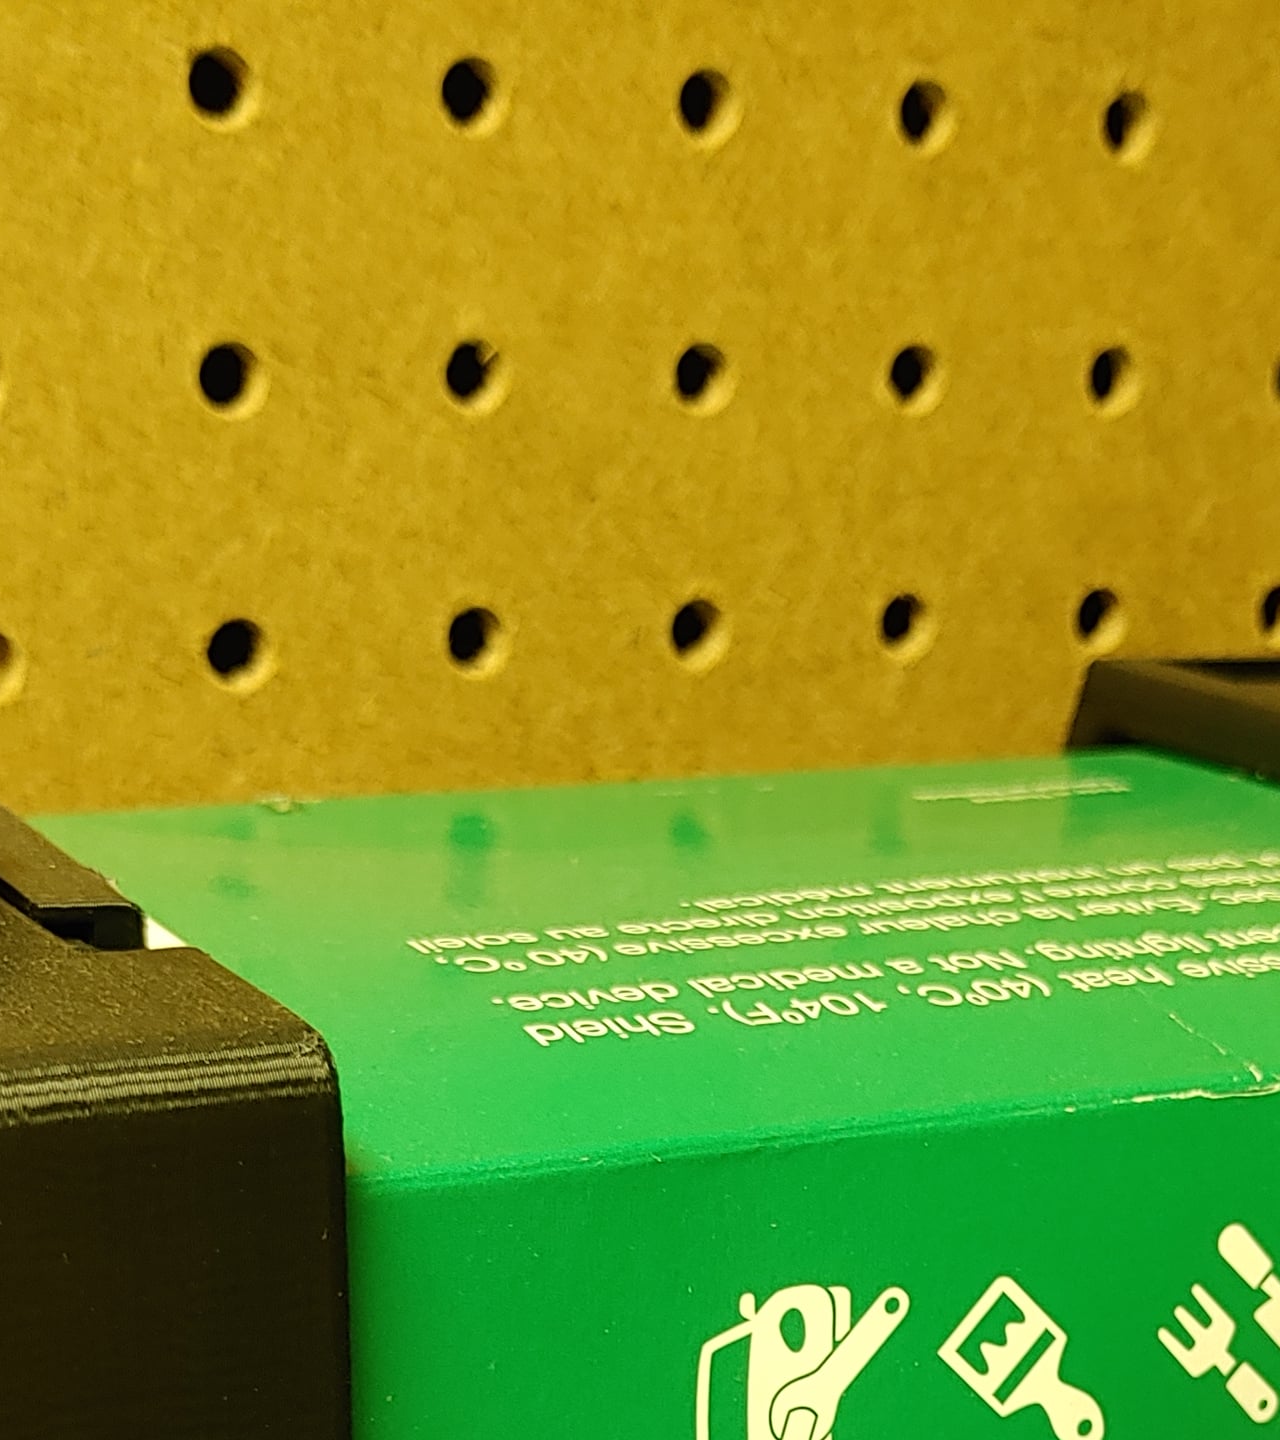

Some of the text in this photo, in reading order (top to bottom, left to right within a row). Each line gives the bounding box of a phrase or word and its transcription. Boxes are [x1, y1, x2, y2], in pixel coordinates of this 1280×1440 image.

[876, 866, 1110, 895] instrument
[1042, 877, 1178, 898] contre
[678, 884, 874, 914] médical.
[784, 889, 1046, 920] l'exposition
[1020, 903, 1076, 921] la
[1076, 893, 1204, 917] Éviter
[544, 925, 610, 941] au
[616, 911, 780, 935] directe
[858, 908, 1021, 935] chaleur
[406, 931, 539, 954] soleil
[613, 924, 848, 956] excessive
[1024, 931, 1212, 961] lighting.
[884, 958, 924, 975] a
[927, 949, 1028, 974] Not
[686, 962, 884, 998] medical
[1057, 964, 1175, 992] heat
[491, 982, 679, 1011] device.
[523, 1011, 695, 1047] Shield
